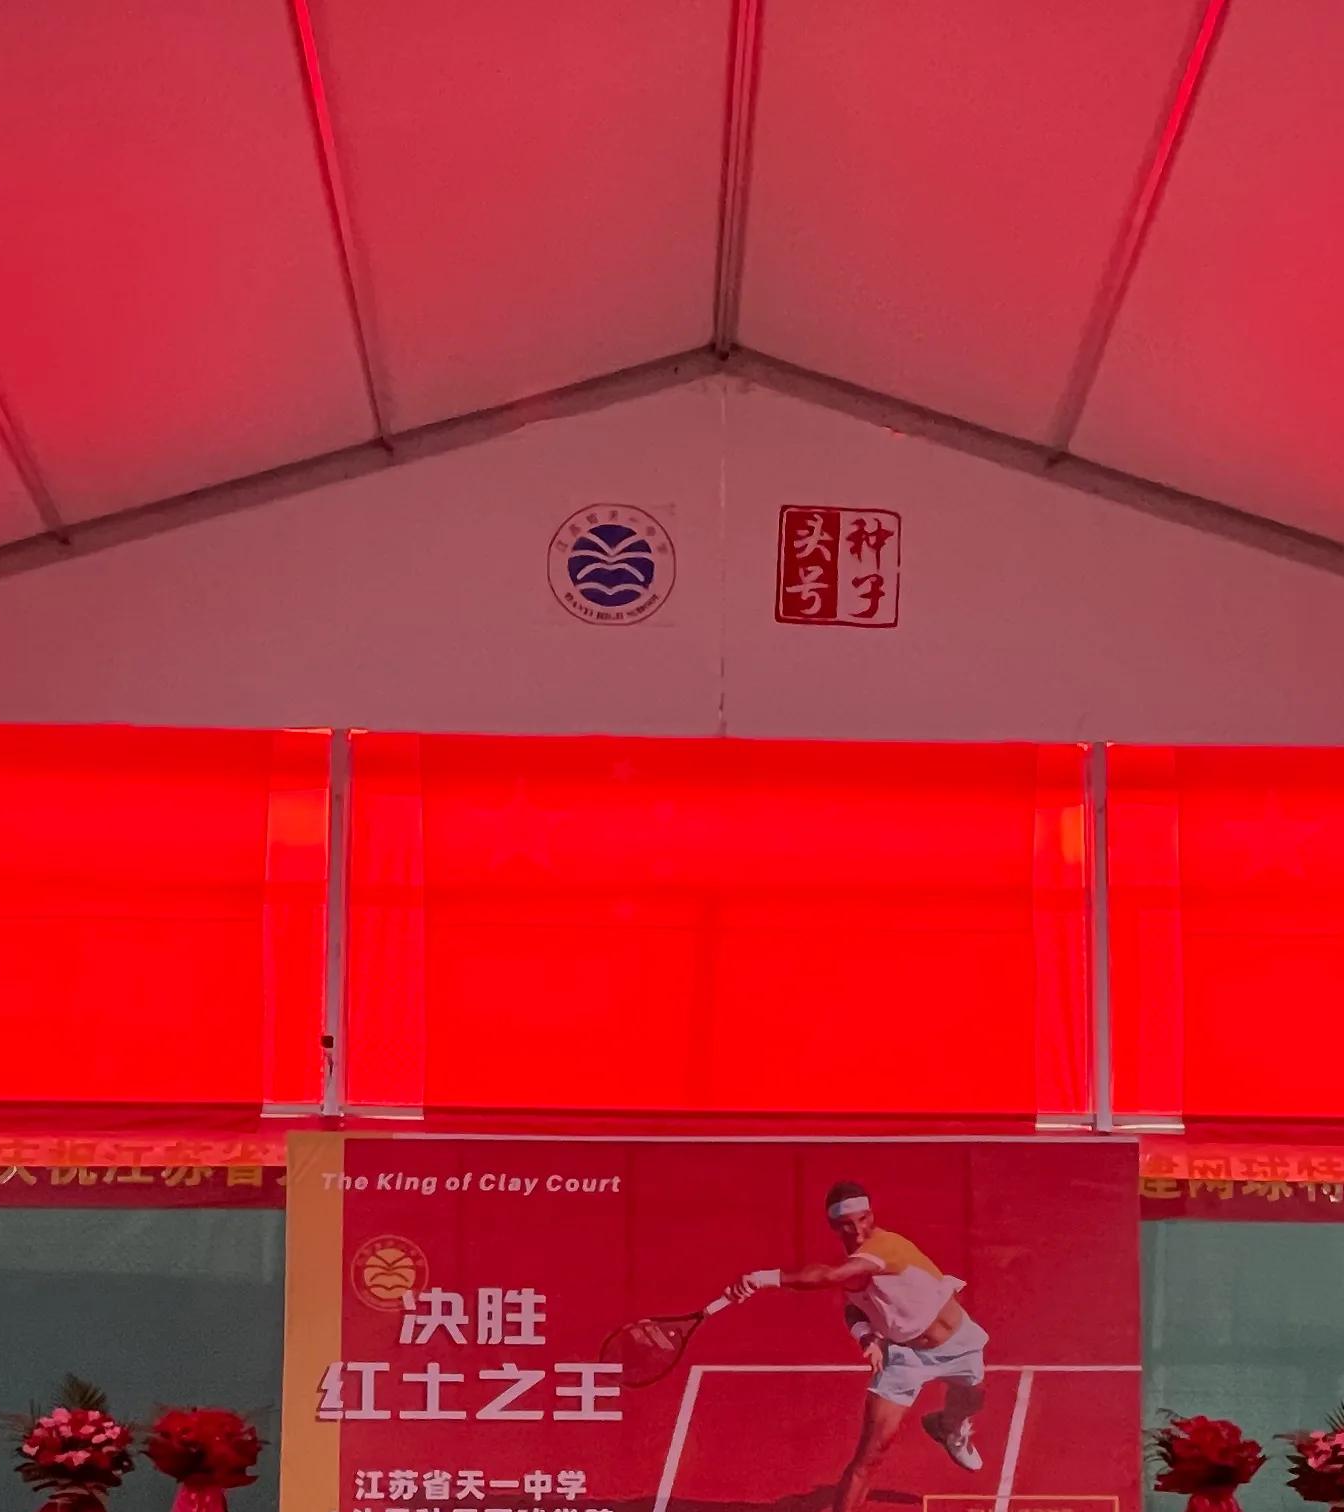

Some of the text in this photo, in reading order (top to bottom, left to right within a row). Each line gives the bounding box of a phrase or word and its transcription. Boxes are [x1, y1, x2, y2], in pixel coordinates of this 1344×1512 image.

[786, 512, 834, 616] 头号
[845, 517, 895, 620] 种子
[321, 1172, 621, 1196] The King of Clay Court
[399, 1286, 548, 1345] 决胜
[317, 1360, 624, 1422] 红土之王
[354, 1469, 587, 1501] 江苏省天一中学
